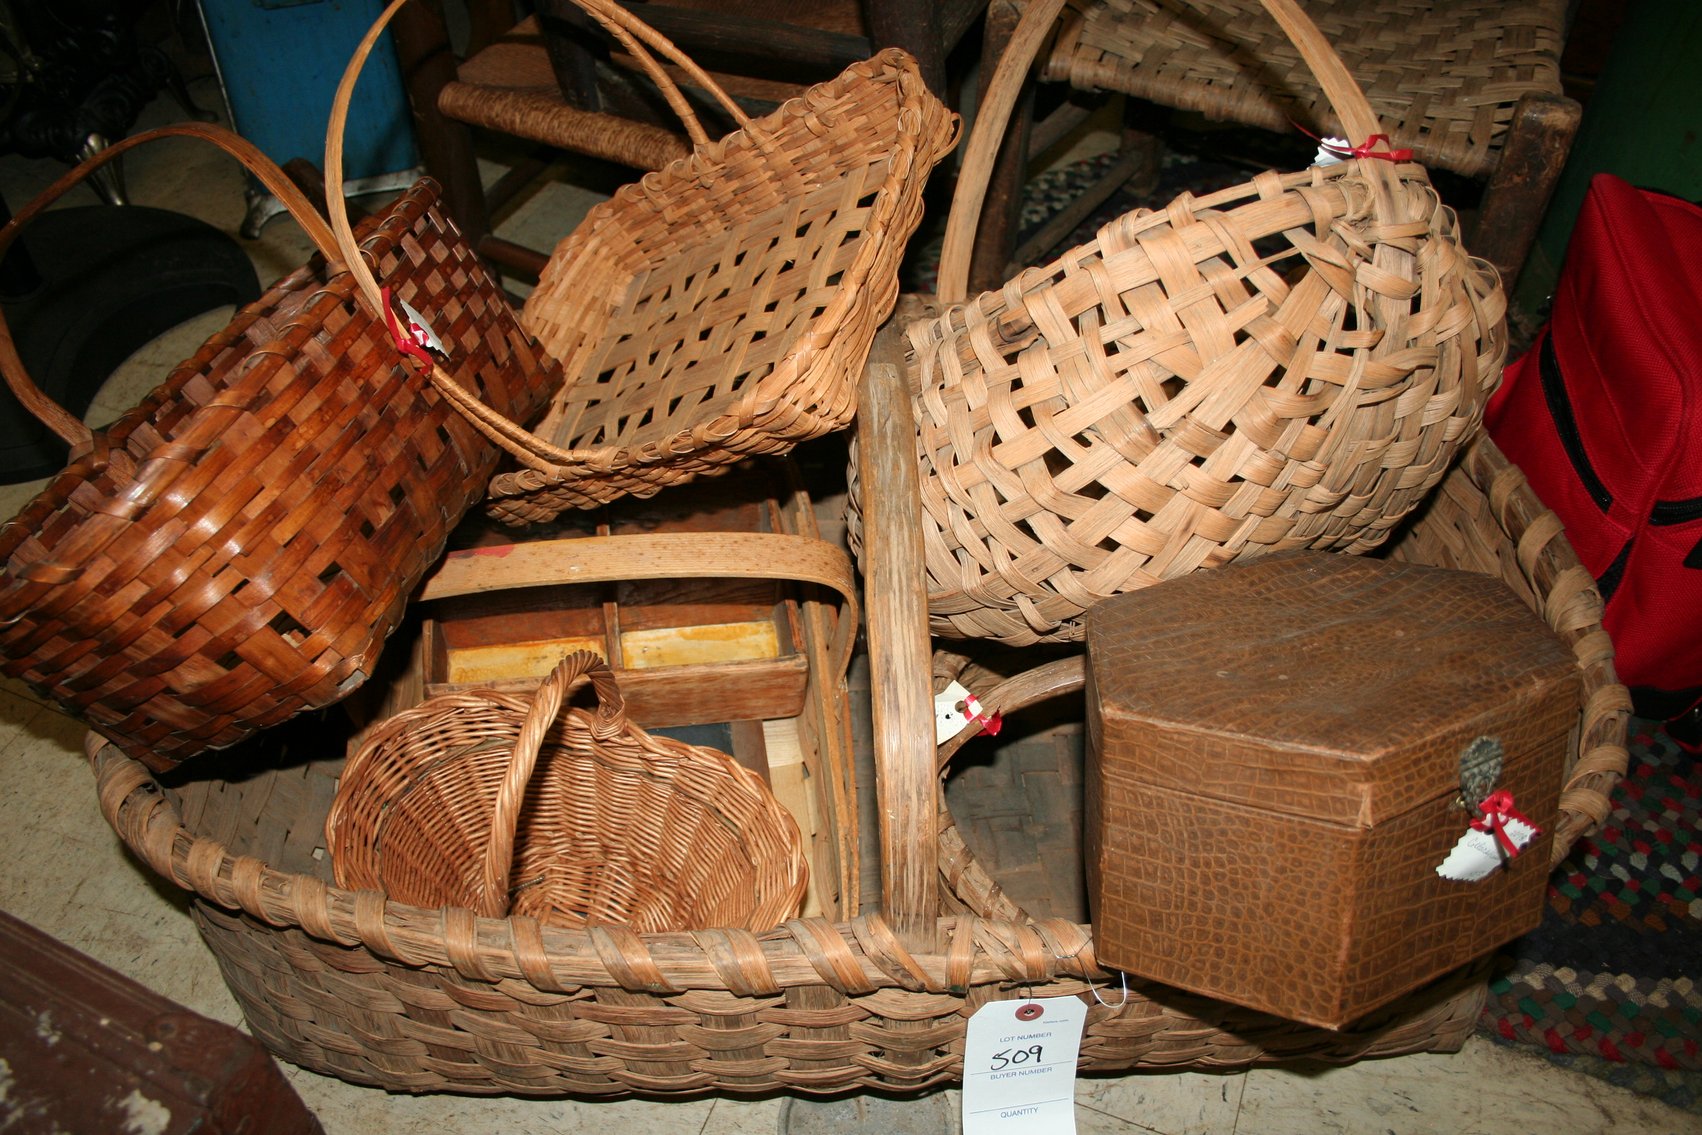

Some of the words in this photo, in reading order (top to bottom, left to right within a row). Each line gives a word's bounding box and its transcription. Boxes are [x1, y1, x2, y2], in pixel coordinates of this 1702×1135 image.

[1017, 1032, 1052, 1041] NUMBER
[990, 1045, 1043, 1071] 509
[990, 1071, 1017, 1080] BUYER
[1018, 1066, 1053, 1077] NUMBER
[1000, 1106, 1039, 1119] QUANTITY
